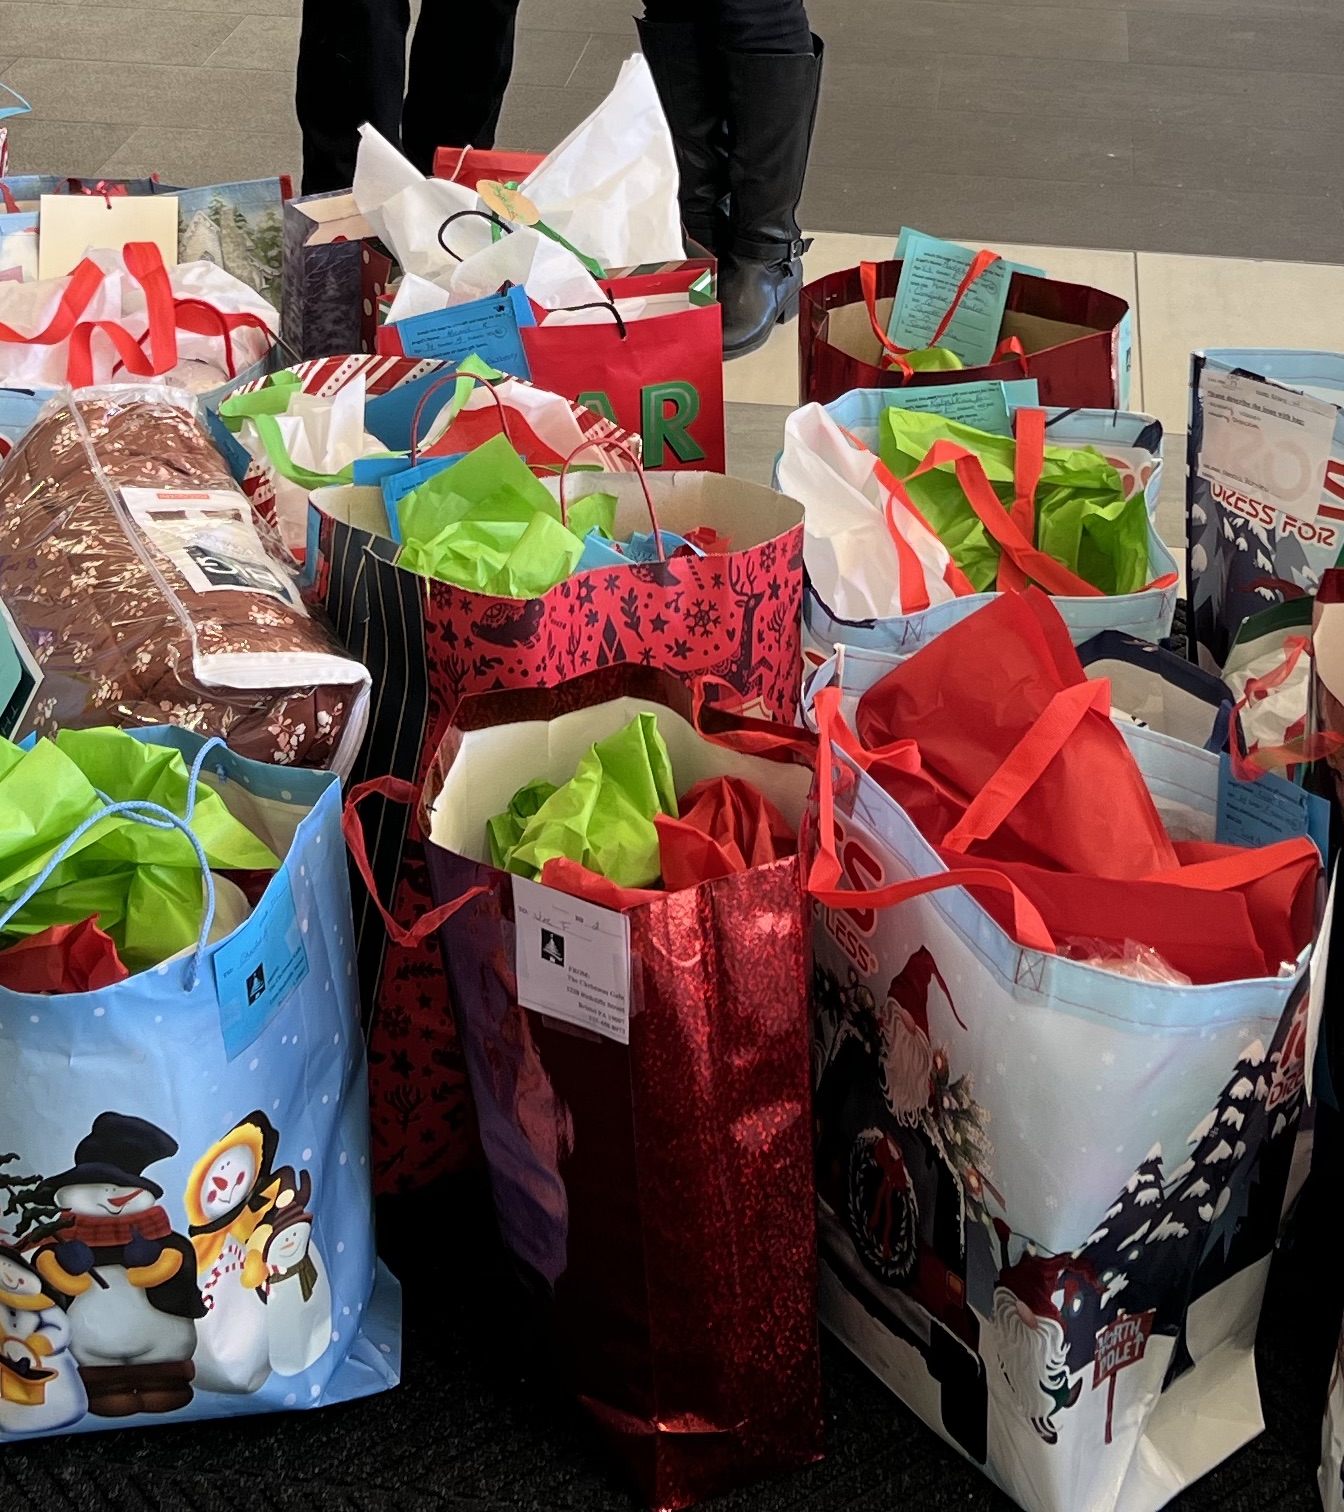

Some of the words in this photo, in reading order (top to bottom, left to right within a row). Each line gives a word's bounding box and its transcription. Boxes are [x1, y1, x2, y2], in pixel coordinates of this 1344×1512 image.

[1281, 515, 1336, 547] FOR
[1097, 1320, 1141, 1359] NORTH
[1099, 1344, 1131, 1374] POLE
